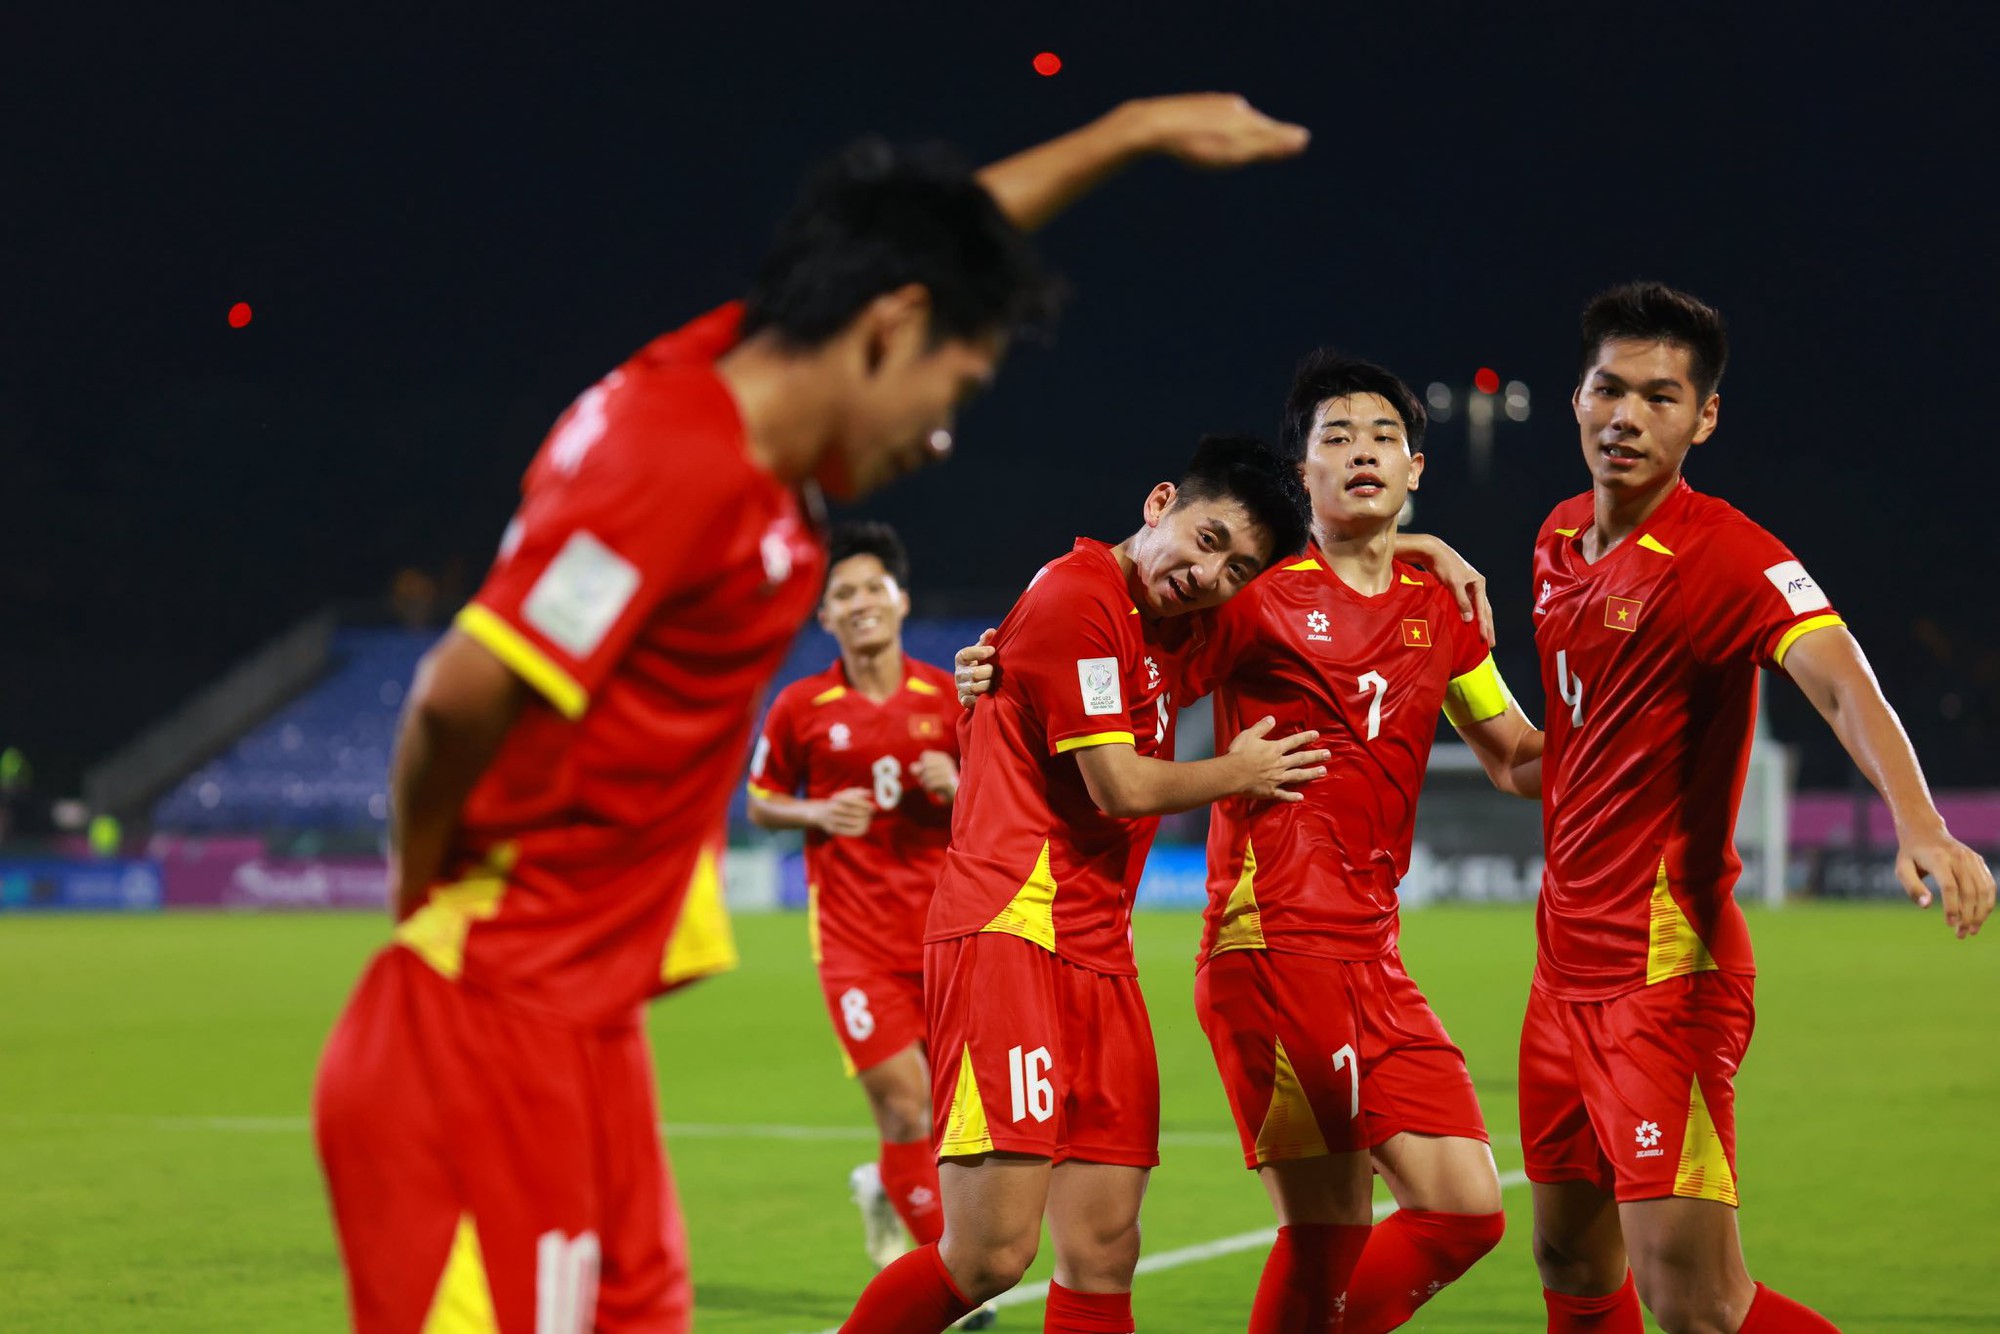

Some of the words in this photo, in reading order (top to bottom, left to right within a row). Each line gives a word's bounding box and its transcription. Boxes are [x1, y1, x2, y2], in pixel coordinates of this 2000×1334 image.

[1788, 577, 1812, 593] AFC
[1357, 670, 1388, 741] 7
[1556, 649, 1584, 728] 4
[872, 755, 902, 809] 8
[841, 988, 874, 1040] 8
[1009, 1046, 1054, 1123] 16
[1332, 1044, 1359, 1119] 7
